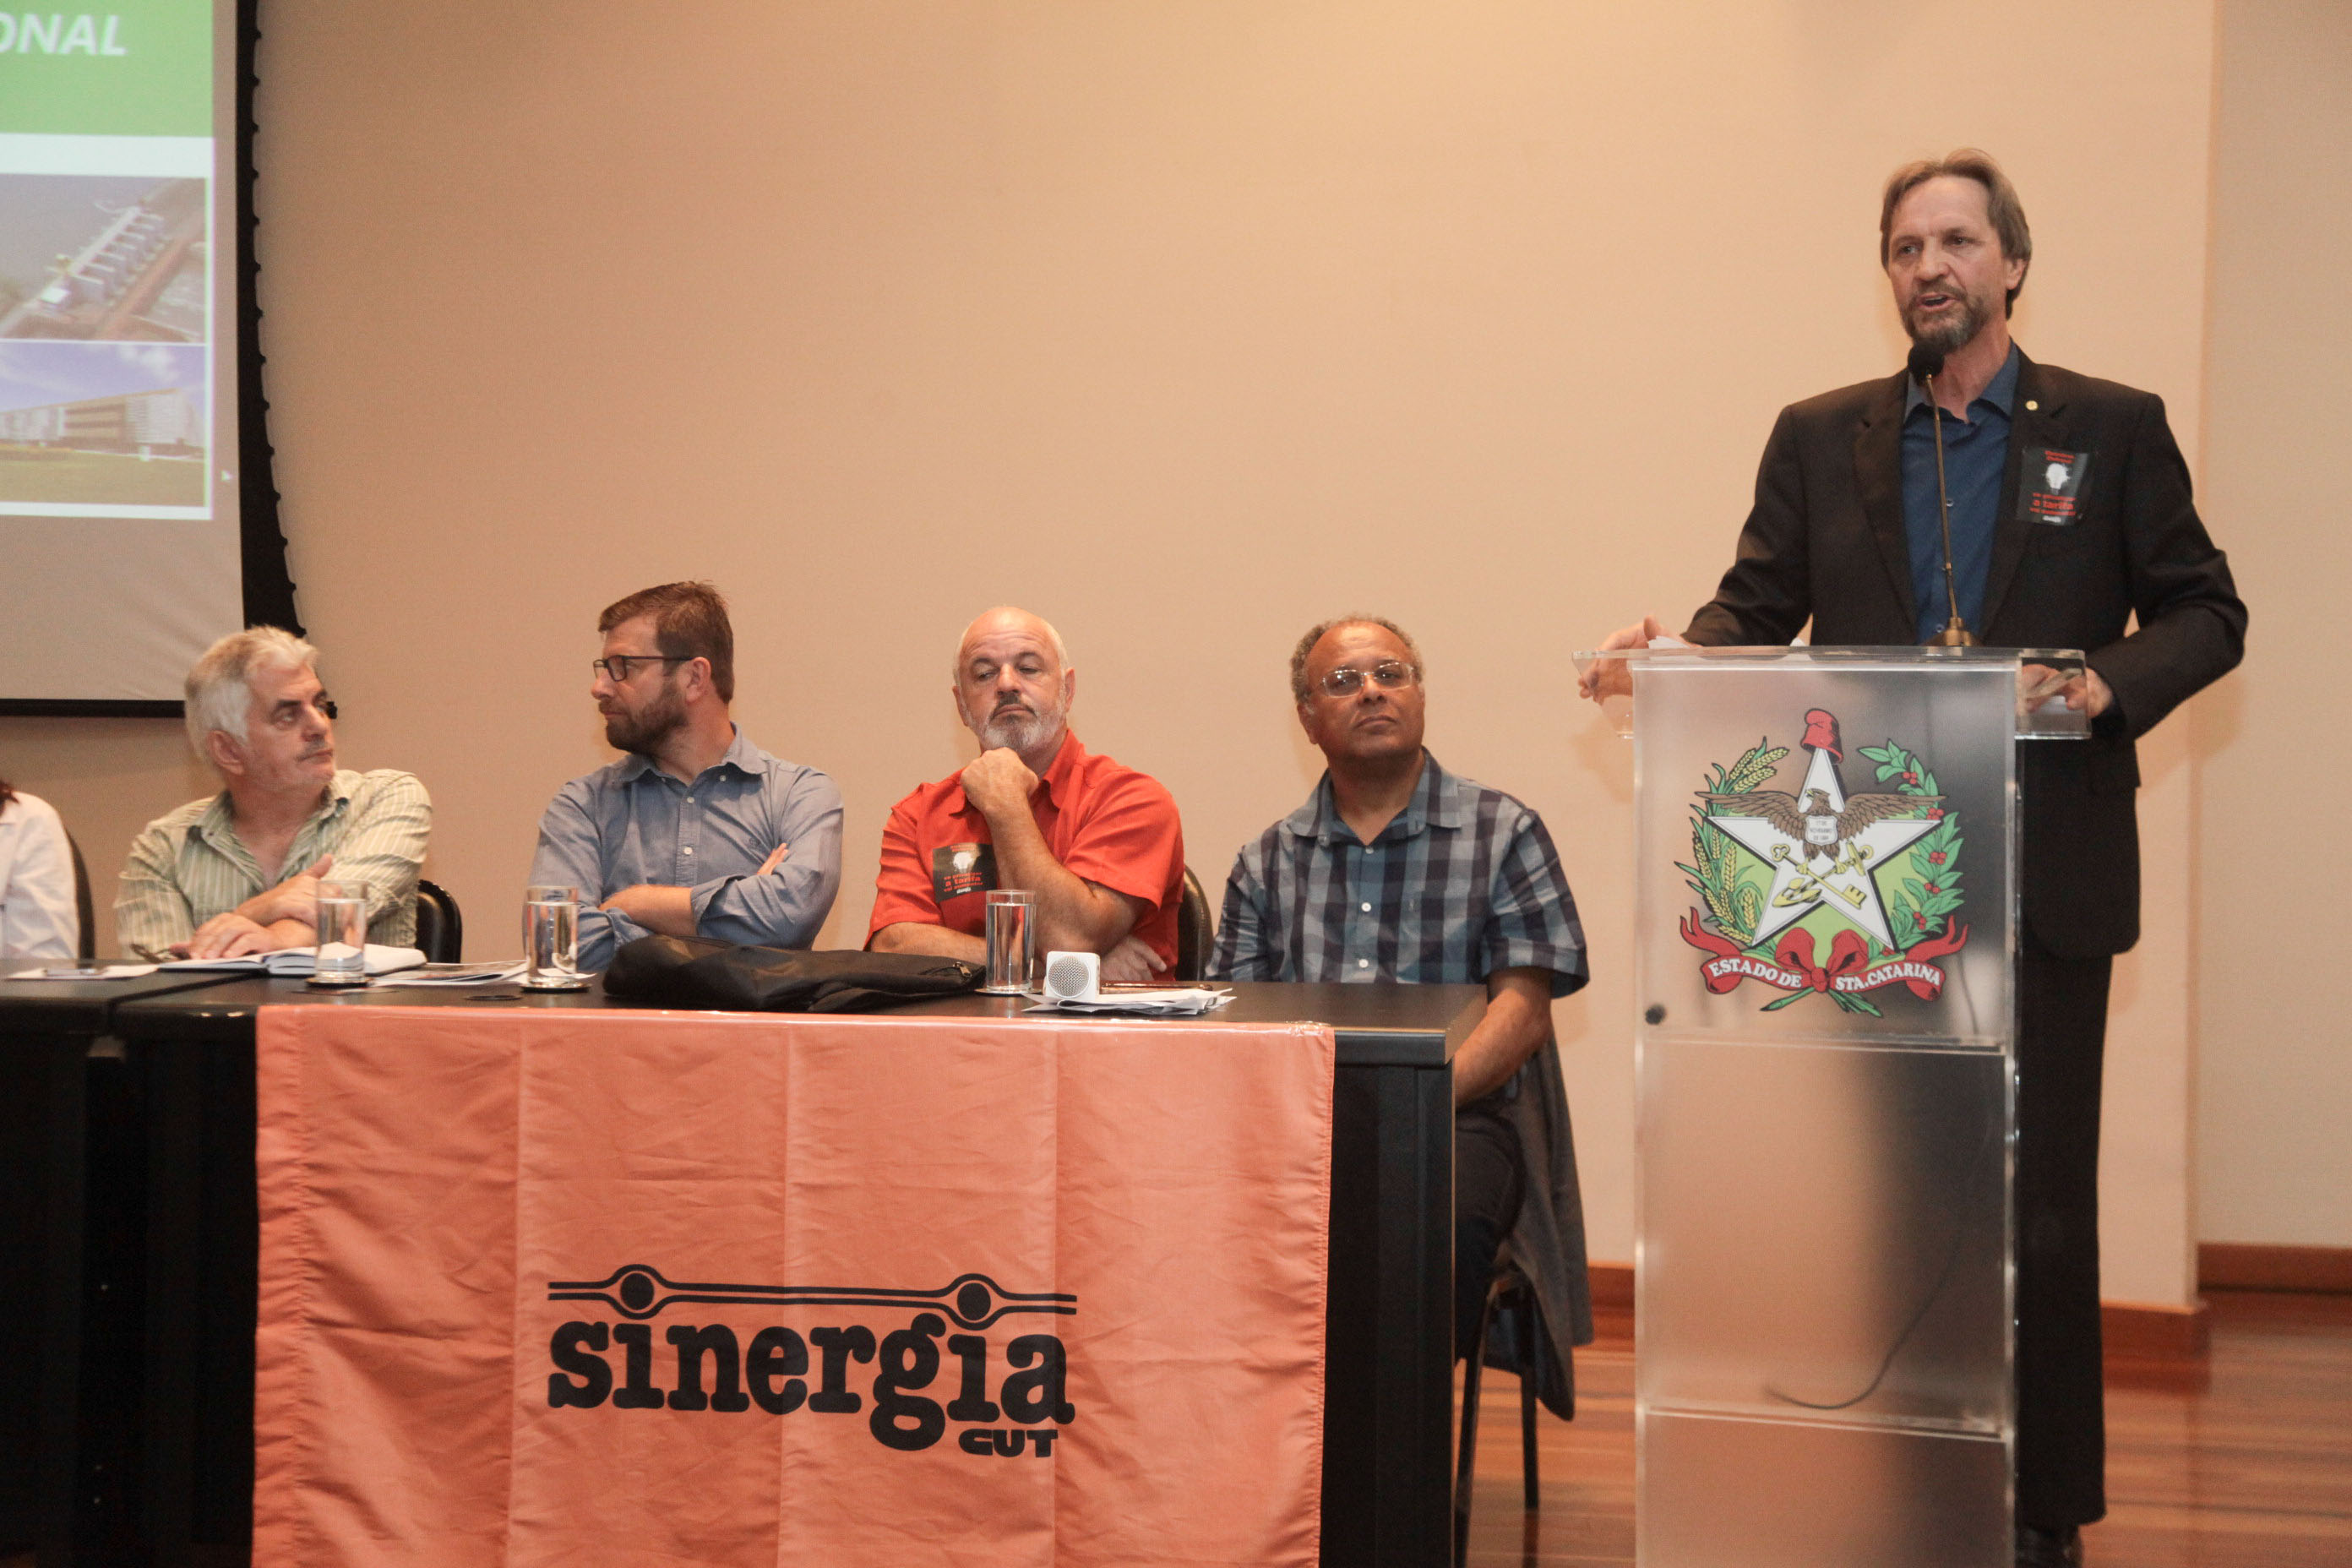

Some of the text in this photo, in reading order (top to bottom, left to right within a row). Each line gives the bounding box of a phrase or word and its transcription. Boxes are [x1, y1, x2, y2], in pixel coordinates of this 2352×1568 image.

[954, 876, 980, 885] tarifa
[1708, 958, 1802, 988] ESTADO DE
[547, 1313, 1076, 1451] sinergia
[959, 1429, 1059, 1458] CUT
